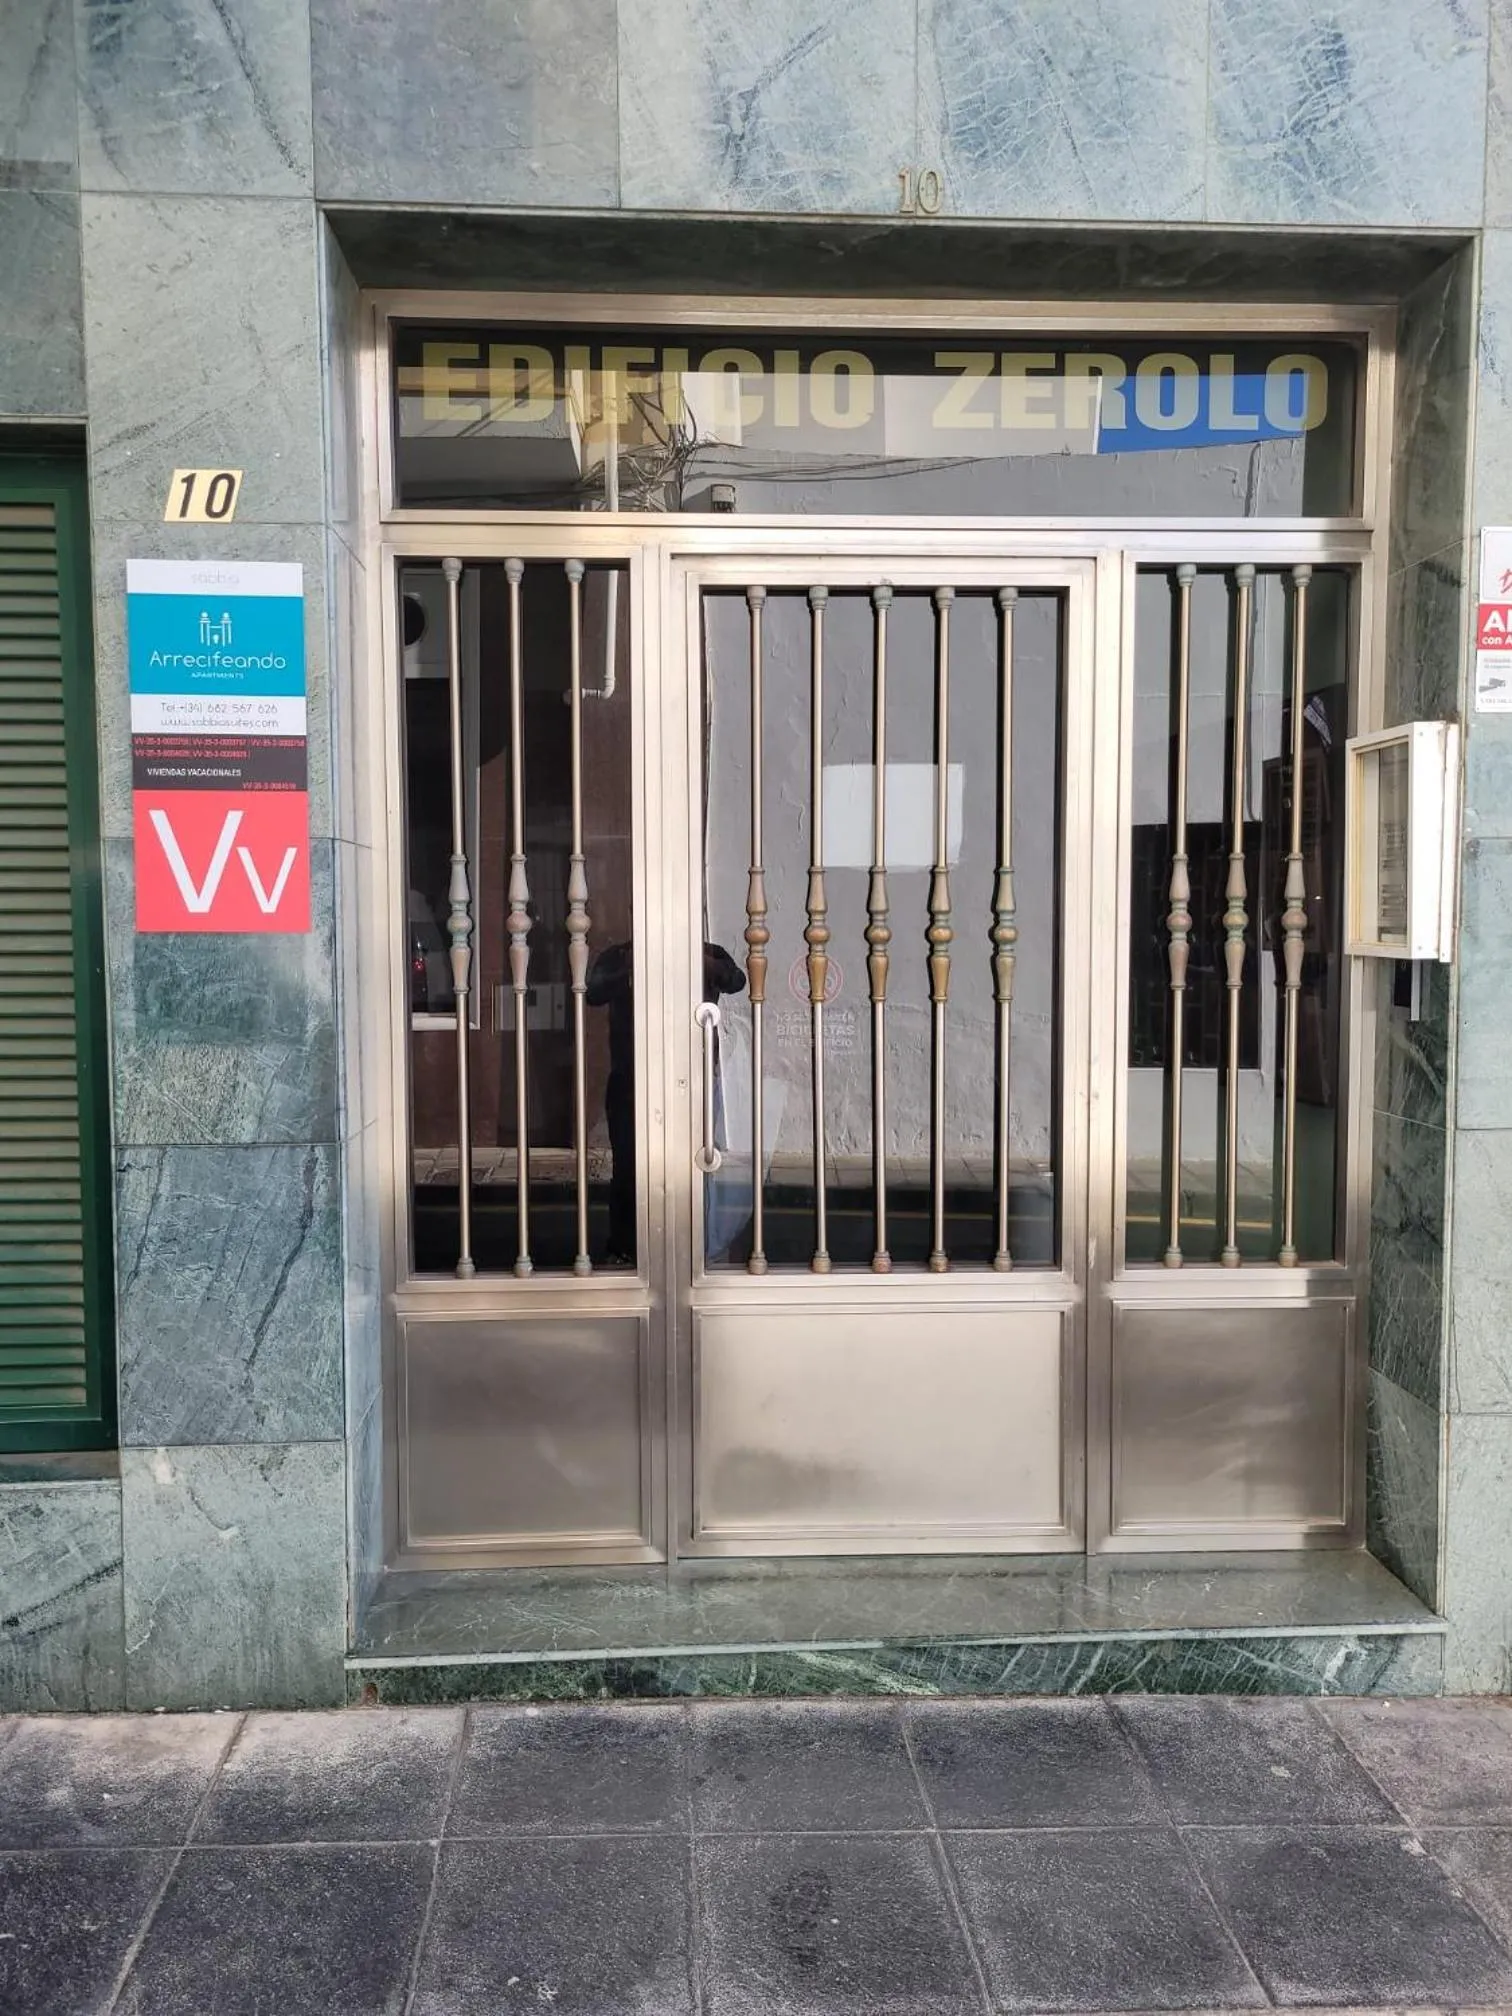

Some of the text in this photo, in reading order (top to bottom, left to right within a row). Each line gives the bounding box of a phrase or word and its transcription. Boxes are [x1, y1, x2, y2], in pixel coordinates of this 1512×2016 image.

[898, 167, 943, 214] 10
[421, 342, 1329, 431] EDIFICIO ZEROLO
[179, 472, 236, 519] 10
[1482, 609, 1512, 633] A
[1481, 636, 1502, 645] con
[149, 650, 287, 669] Arrecifeando
[258, 703, 278, 714] 626
[147, 767, 242, 777] VIVIENDAS VACACIONALES
